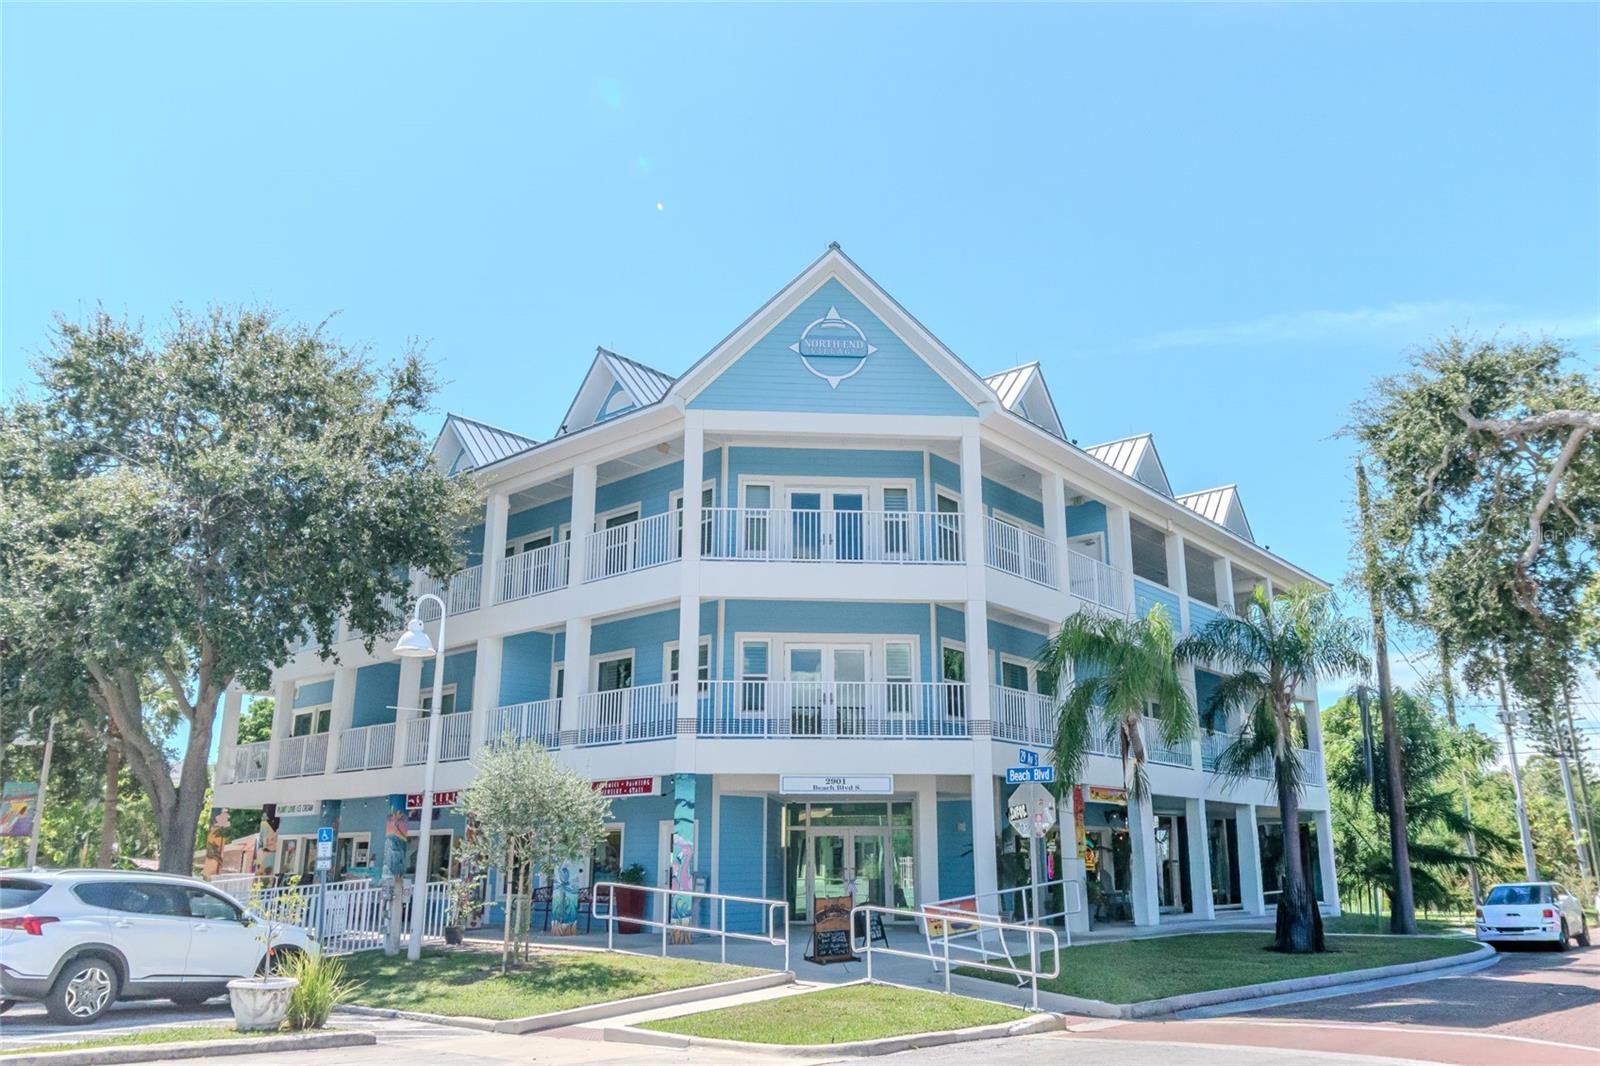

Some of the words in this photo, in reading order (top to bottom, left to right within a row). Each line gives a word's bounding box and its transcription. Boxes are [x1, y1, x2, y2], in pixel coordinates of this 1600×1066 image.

[804, 339, 842, 349] NORTH
[843, 340, 865, 349] END
[1009, 769, 1031, 782] Beach
[1033, 768, 1050, 780] Blvd
[415, 792, 457, 804] GLERY
